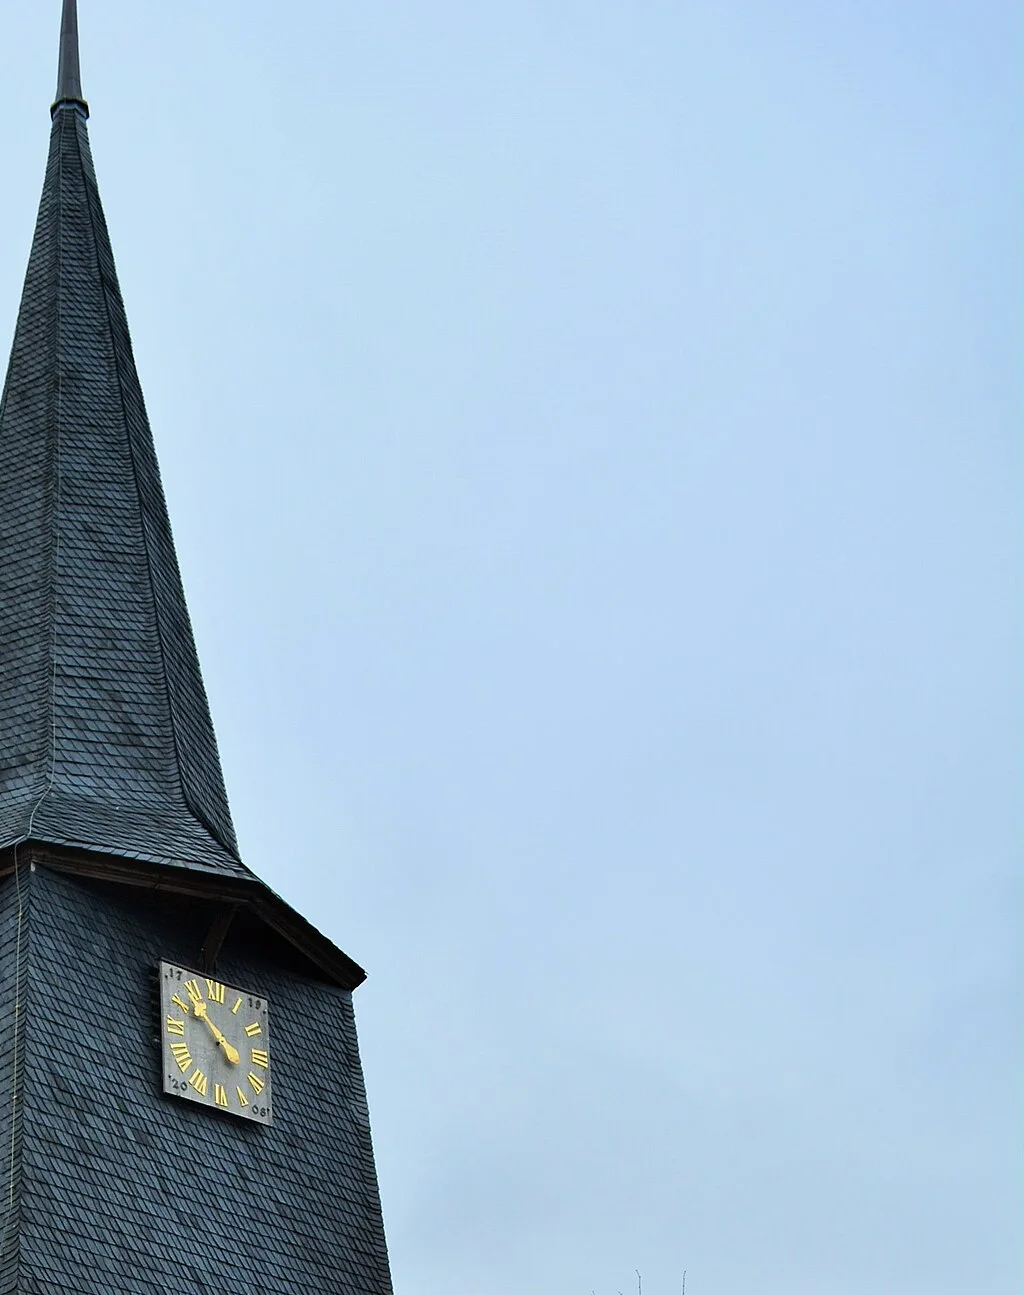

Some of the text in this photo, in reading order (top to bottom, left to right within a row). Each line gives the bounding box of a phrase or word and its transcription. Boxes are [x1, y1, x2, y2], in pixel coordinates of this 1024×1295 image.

[205, 978, 225, 1005] XII
[172, 993, 189, 1014] X
[231, 996, 242, 1015] I
[167, 1015, 184, 1035] IX
[245, 1021, 262, 1037] II
[169, 1042, 192, 1073] VIII
[251, 1048, 268, 1068] III
[172, 1078, 188, 1090] 20
[188, 1068, 207, 1096] VII
[247, 1071, 265, 1095] IV
[215, 1084, 228, 1107] VI
[236, 1086, 249, 1107] V
